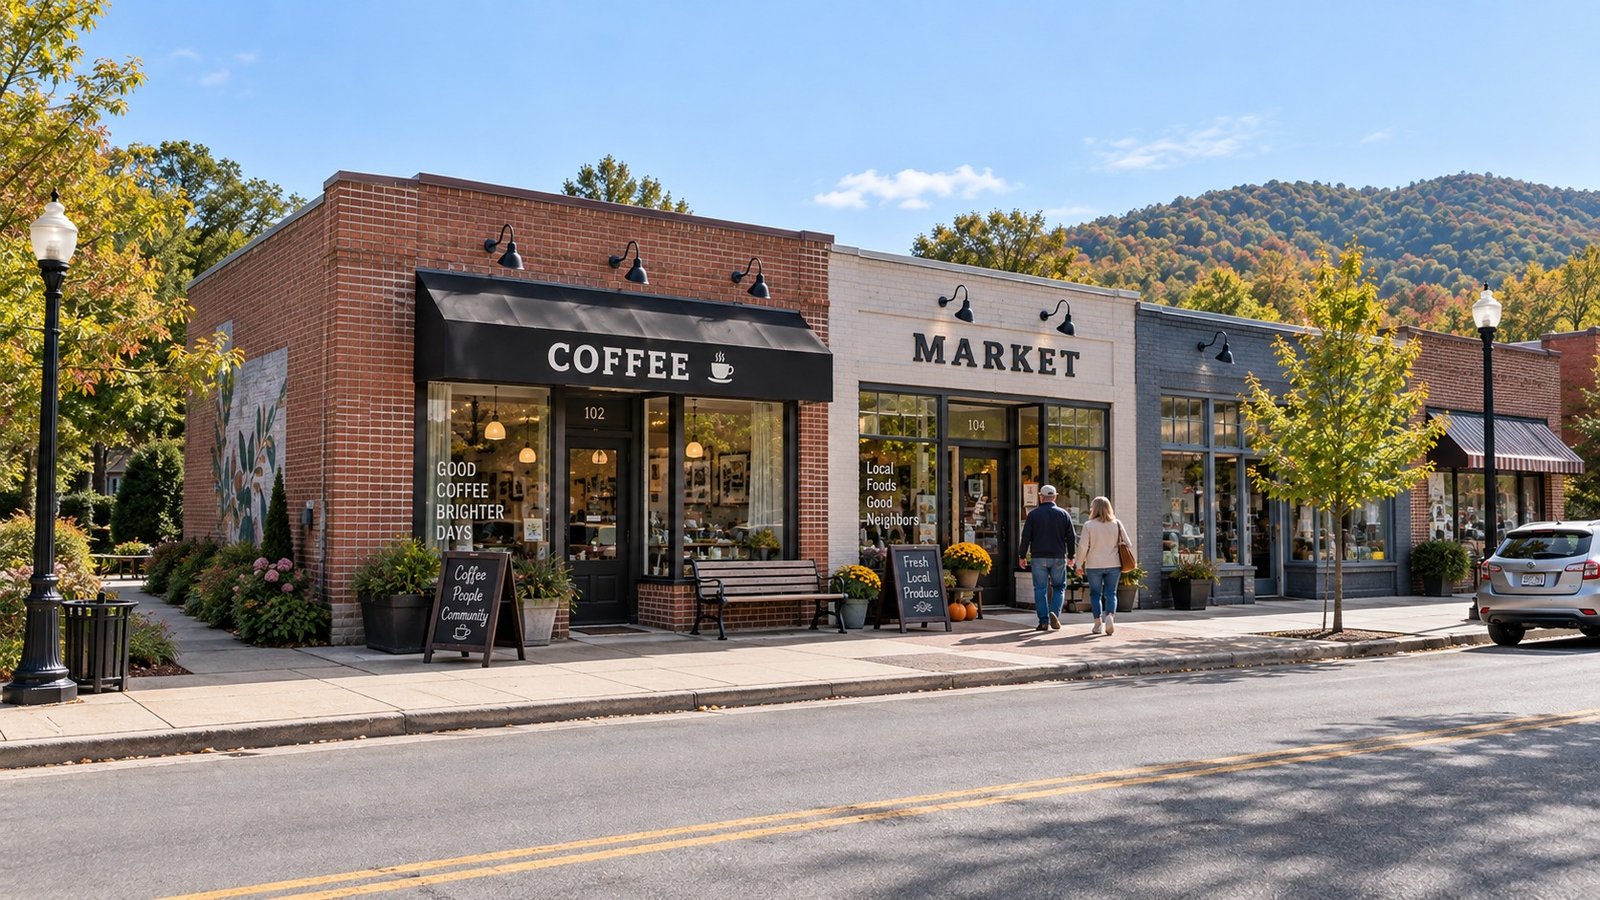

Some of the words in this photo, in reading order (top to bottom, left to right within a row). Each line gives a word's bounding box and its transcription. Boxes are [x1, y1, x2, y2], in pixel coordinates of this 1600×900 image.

[547, 342, 690, 381] COFFEE
[913, 332, 1080, 378] MARKET
[584, 406, 605, 420] 102
[968, 419, 986, 431] 104
[437, 461, 476, 478] GOOD
[866, 461, 894, 475] Local
[437, 482, 489, 499] COFFEE
[866, 478, 897, 492] Foods
[866, 495, 893, 508] Good
[437, 503, 505, 520] BRIGHTER
[866, 512, 920, 530] Neighbors
[436, 524, 472, 541] DAYS
[903, 555, 929, 568] Fresh
[454, 564, 487, 585] Coffee
[906, 571, 931, 583] Local
[452, 585, 483, 605] People
[903, 586, 939, 599] Produce
[441, 606, 489, 628] Community
